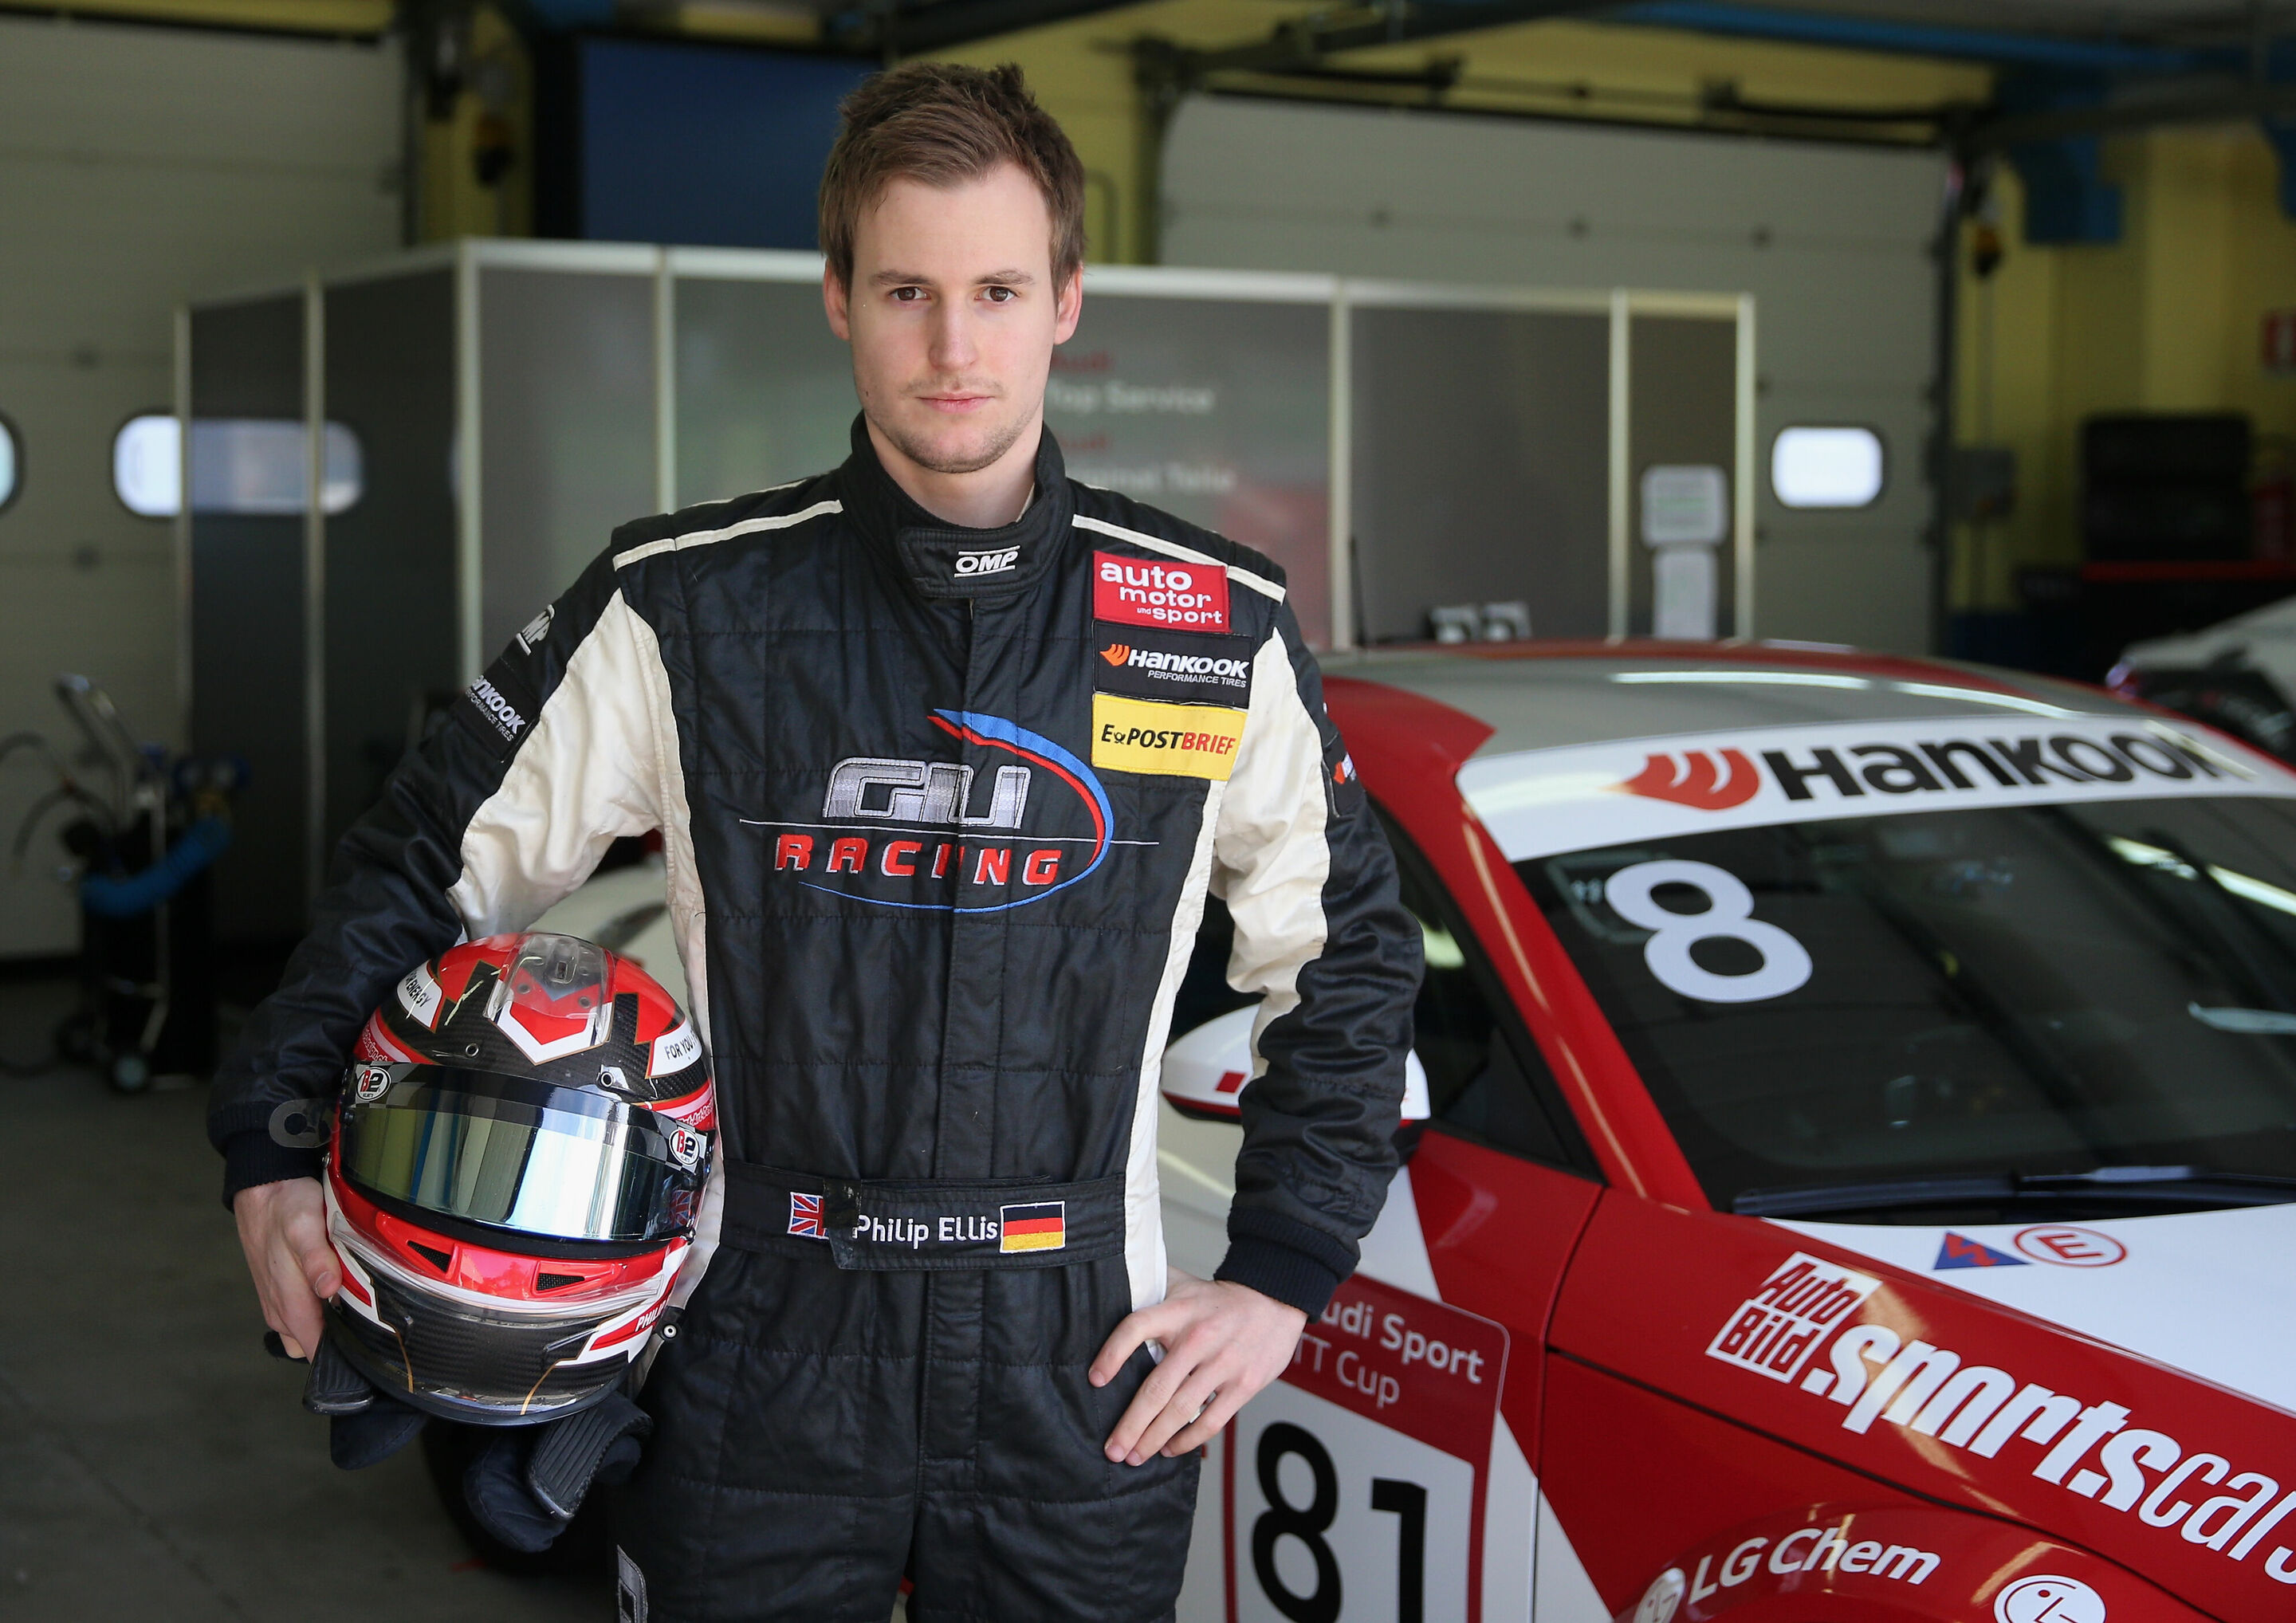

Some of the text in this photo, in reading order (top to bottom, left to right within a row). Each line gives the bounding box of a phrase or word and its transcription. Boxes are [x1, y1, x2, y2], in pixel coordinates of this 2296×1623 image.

[955, 550, 1019, 574] OMP
[1100, 561, 1193, 591] auto
[1119, 586, 1212, 608] motor
[1137, 607, 1223, 624] und sport
[1147, 670, 1247, 689] PERFORMANCE TIRES
[774, 834, 1062, 886] RACING
[1604, 859, 1813, 1004] 8
[664, 1043, 683, 1061] FOR
[852, 1214, 999, 1249] Philip Ellis
[1760, 1261, 1862, 1325] Auto
[1320, 1301, 1484, 1385] udi Sport
[1716, 1307, 1821, 1374] Bild
[1336, 1350, 1400, 1409] Cup
[1249, 1419, 1428, 1623] 81
[1688, 1527, 1941, 1605] LG Chem
